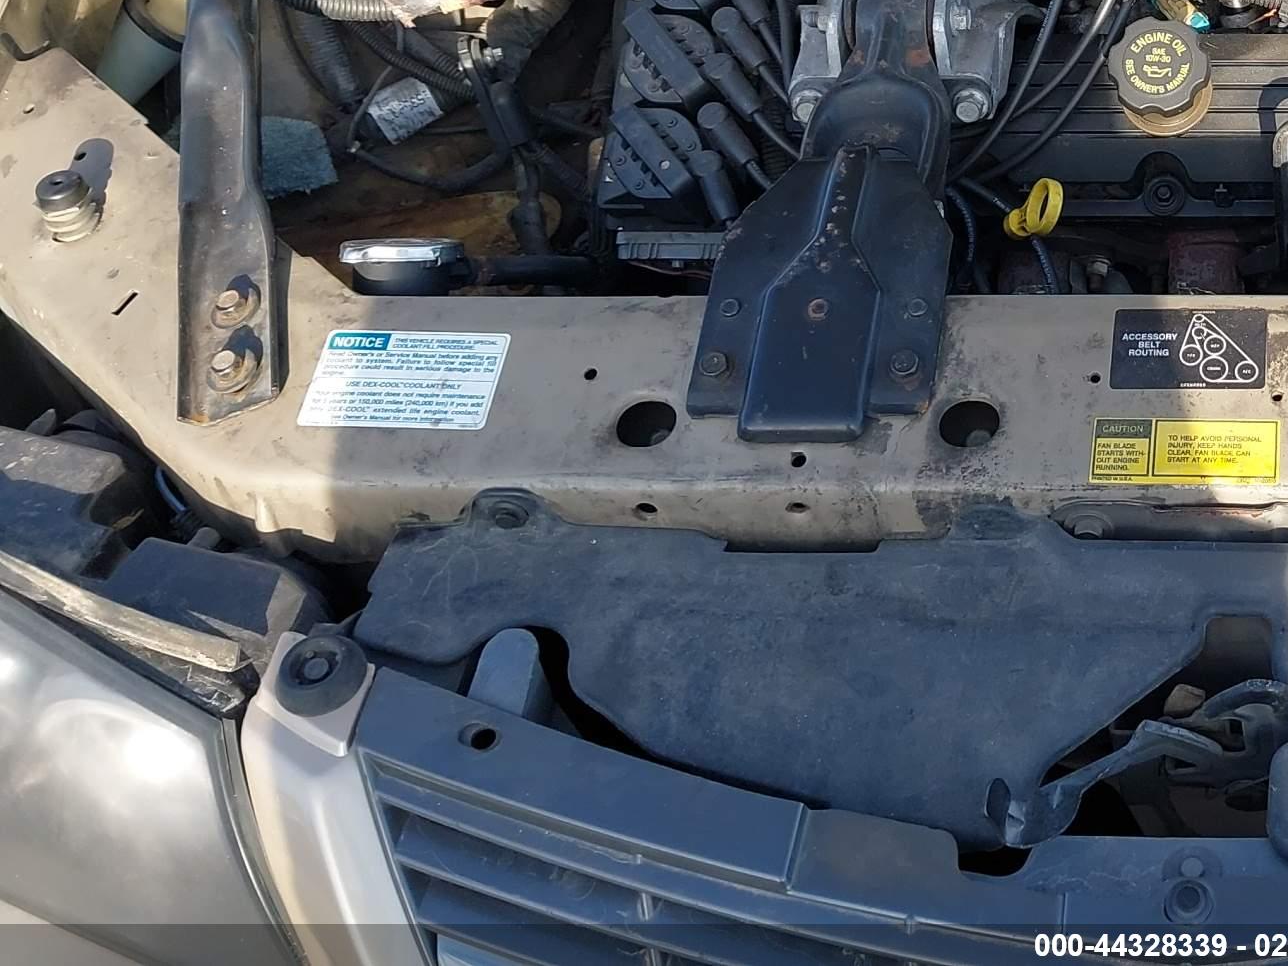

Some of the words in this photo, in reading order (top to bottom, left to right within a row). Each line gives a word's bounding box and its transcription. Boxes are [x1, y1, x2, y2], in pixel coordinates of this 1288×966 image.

[1130, 31, 1173, 53] ENGINE
[1171, 37, 1187, 56] OIL
[1151, 47, 1166, 55] SAE
[1145, 54, 1172, 63] 10W-30
[1125, 59, 1136, 75] SEE
[1165, 62, 1190, 92] MANUAL
[1130, 74, 1166, 94] OWNER'S
[1122, 332, 1178, 341] ACCESSORY
[333, 336, 386, 348] NOTICE
[1138, 341, 1160, 349] BELT
[1128, 349, 1169, 357] ROUTING
[1102, 425, 1144, 433] CAUTION
[1167, 442, 1195, 450] INJURY,
